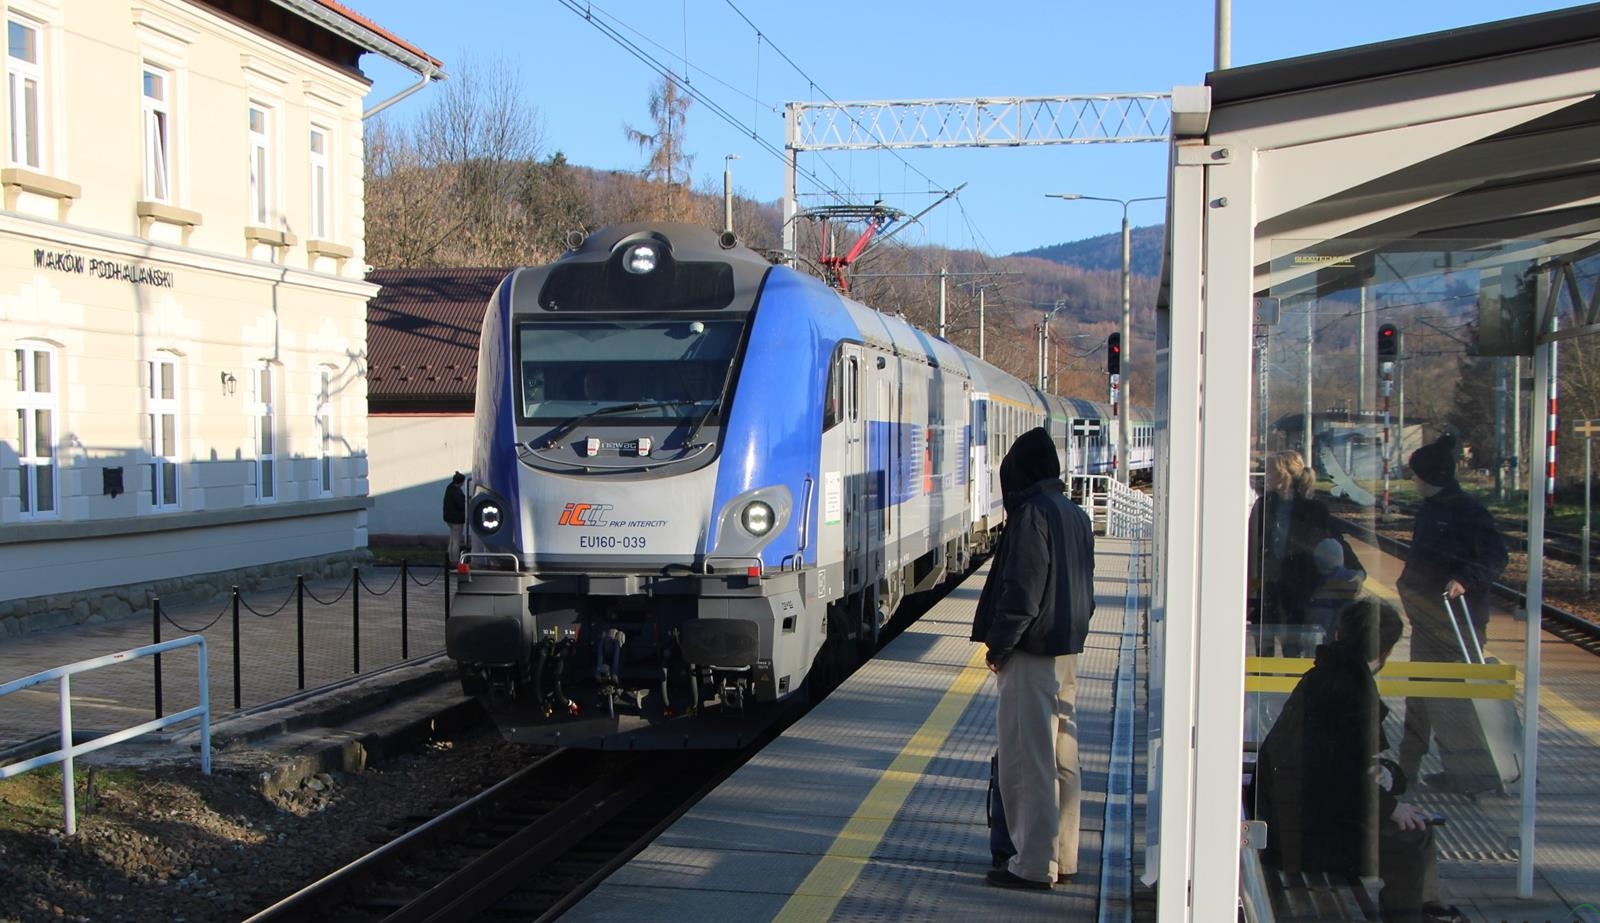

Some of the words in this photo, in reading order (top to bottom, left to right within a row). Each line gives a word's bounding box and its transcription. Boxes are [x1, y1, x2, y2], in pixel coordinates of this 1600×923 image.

[609, 520, 627, 528] PKP
[627, 520, 667, 528] INTERCITY
[580, 535, 646, 548] EU160-039
